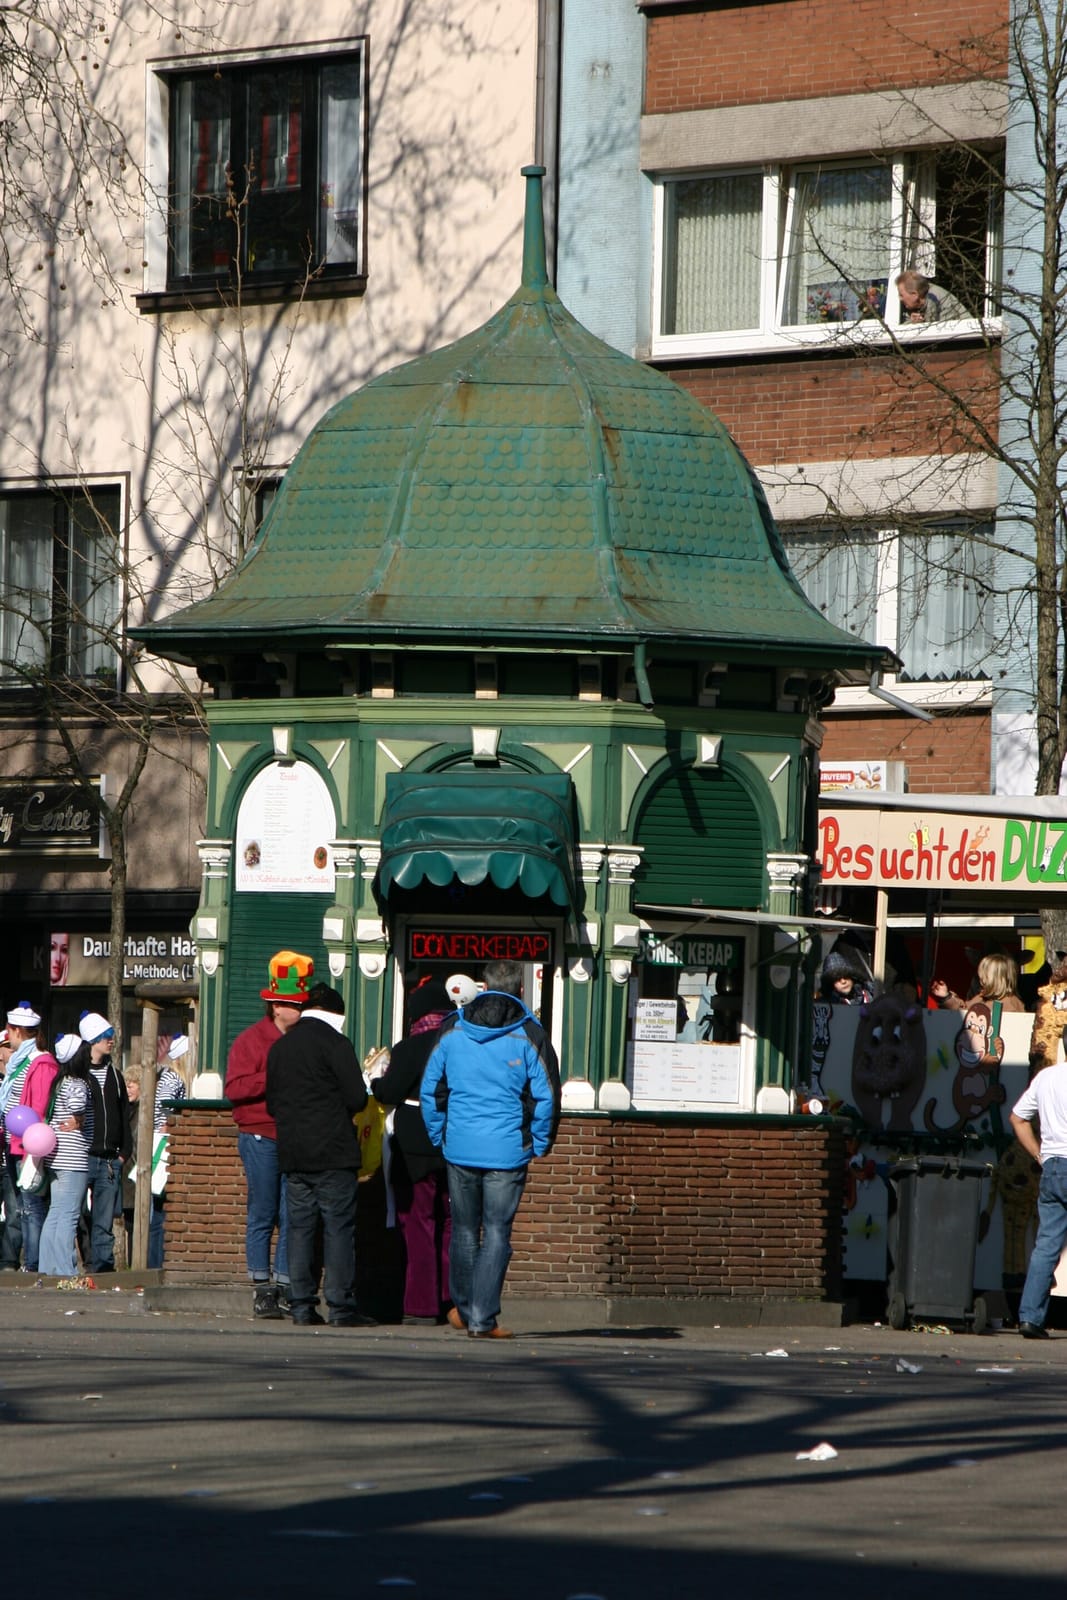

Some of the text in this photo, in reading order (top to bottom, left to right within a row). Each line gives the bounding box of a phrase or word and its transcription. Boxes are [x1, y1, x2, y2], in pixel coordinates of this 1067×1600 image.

[22, 791, 91, 832] Center
[950, 828, 996, 882] den
[1001, 819, 1067, 883] DUZ
[83, 936, 167, 957] Dauhafte
[687, 942, 733, 967] KEBAP
